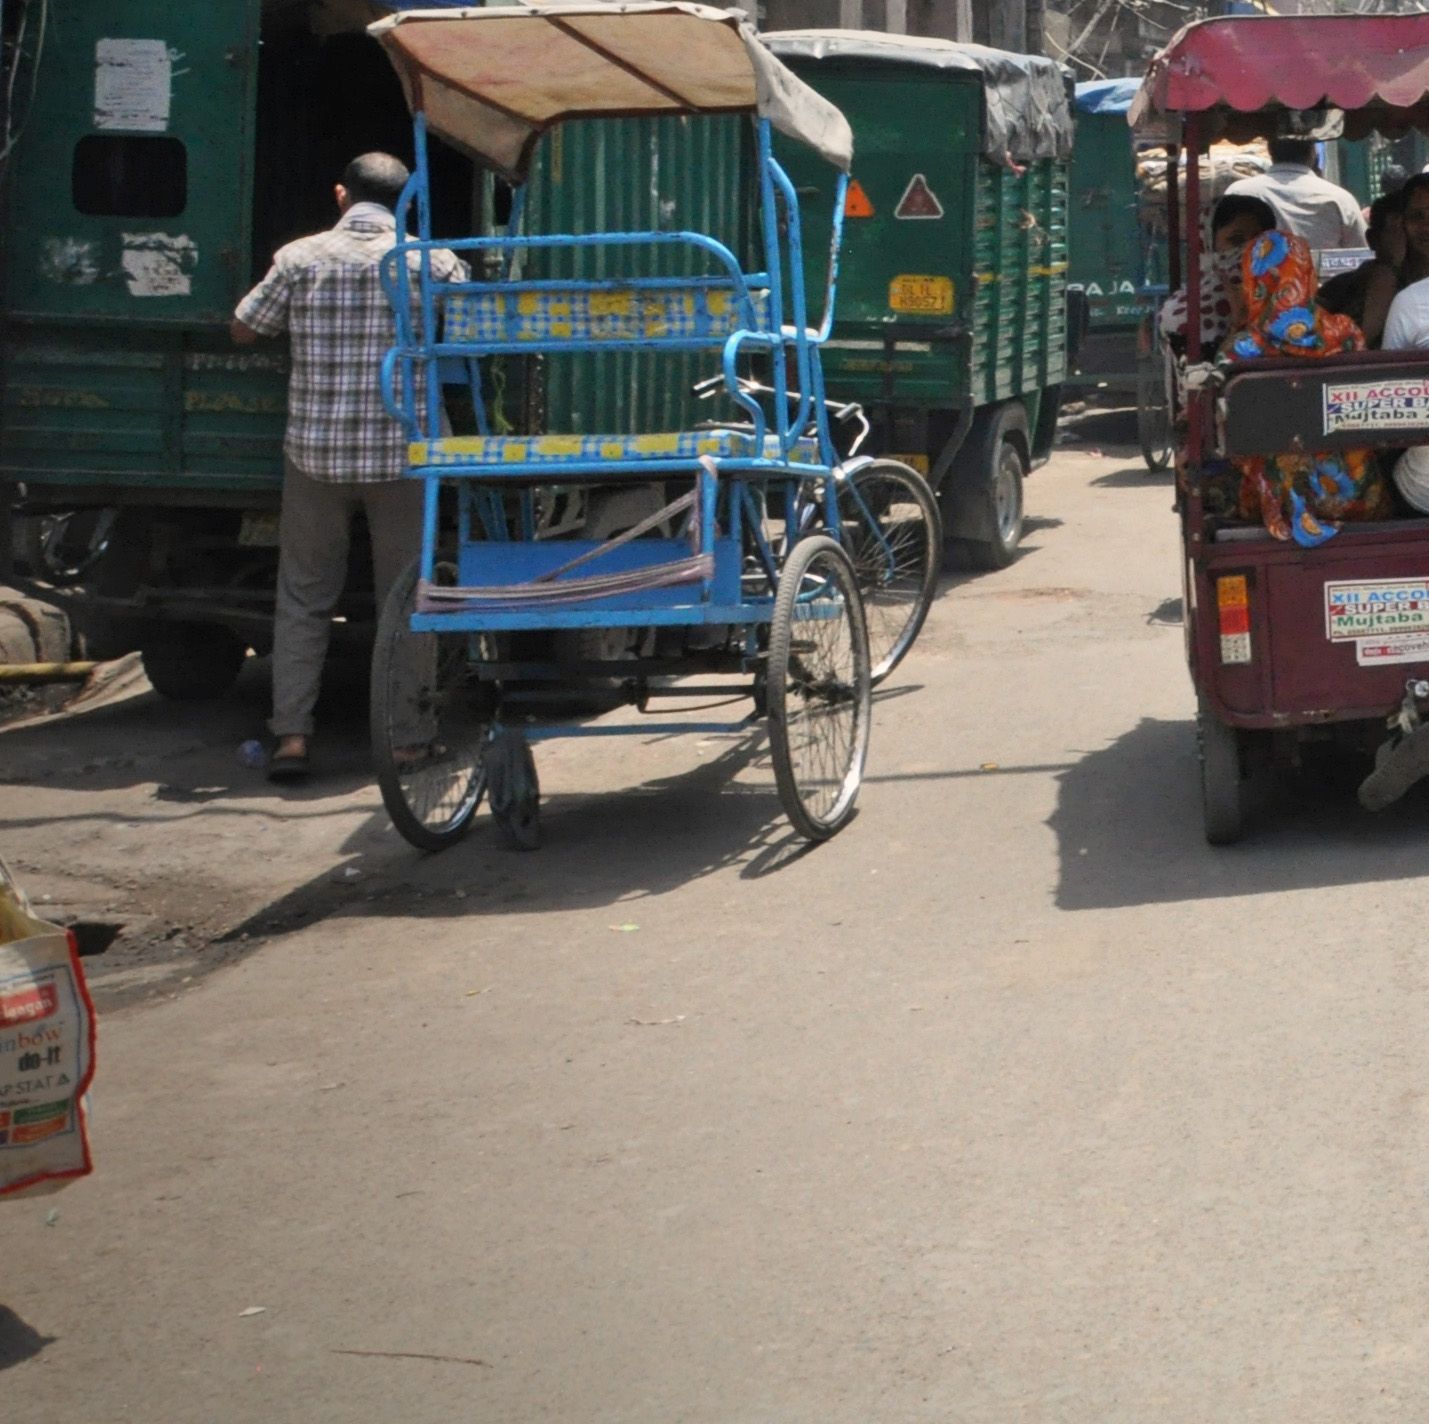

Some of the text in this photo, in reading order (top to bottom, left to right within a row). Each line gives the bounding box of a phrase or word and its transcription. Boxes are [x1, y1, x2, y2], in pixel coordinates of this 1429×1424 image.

[1330, 390, 1359, 403] XII
[1341, 397, 1407, 414] SUPER
[1334, 408, 1418, 425] Mujtaba
[1332, 593, 1359, 603] XII
[1343, 601, 1411, 615] SUPER
[1335, 611, 1424, 628] Mujtaba
